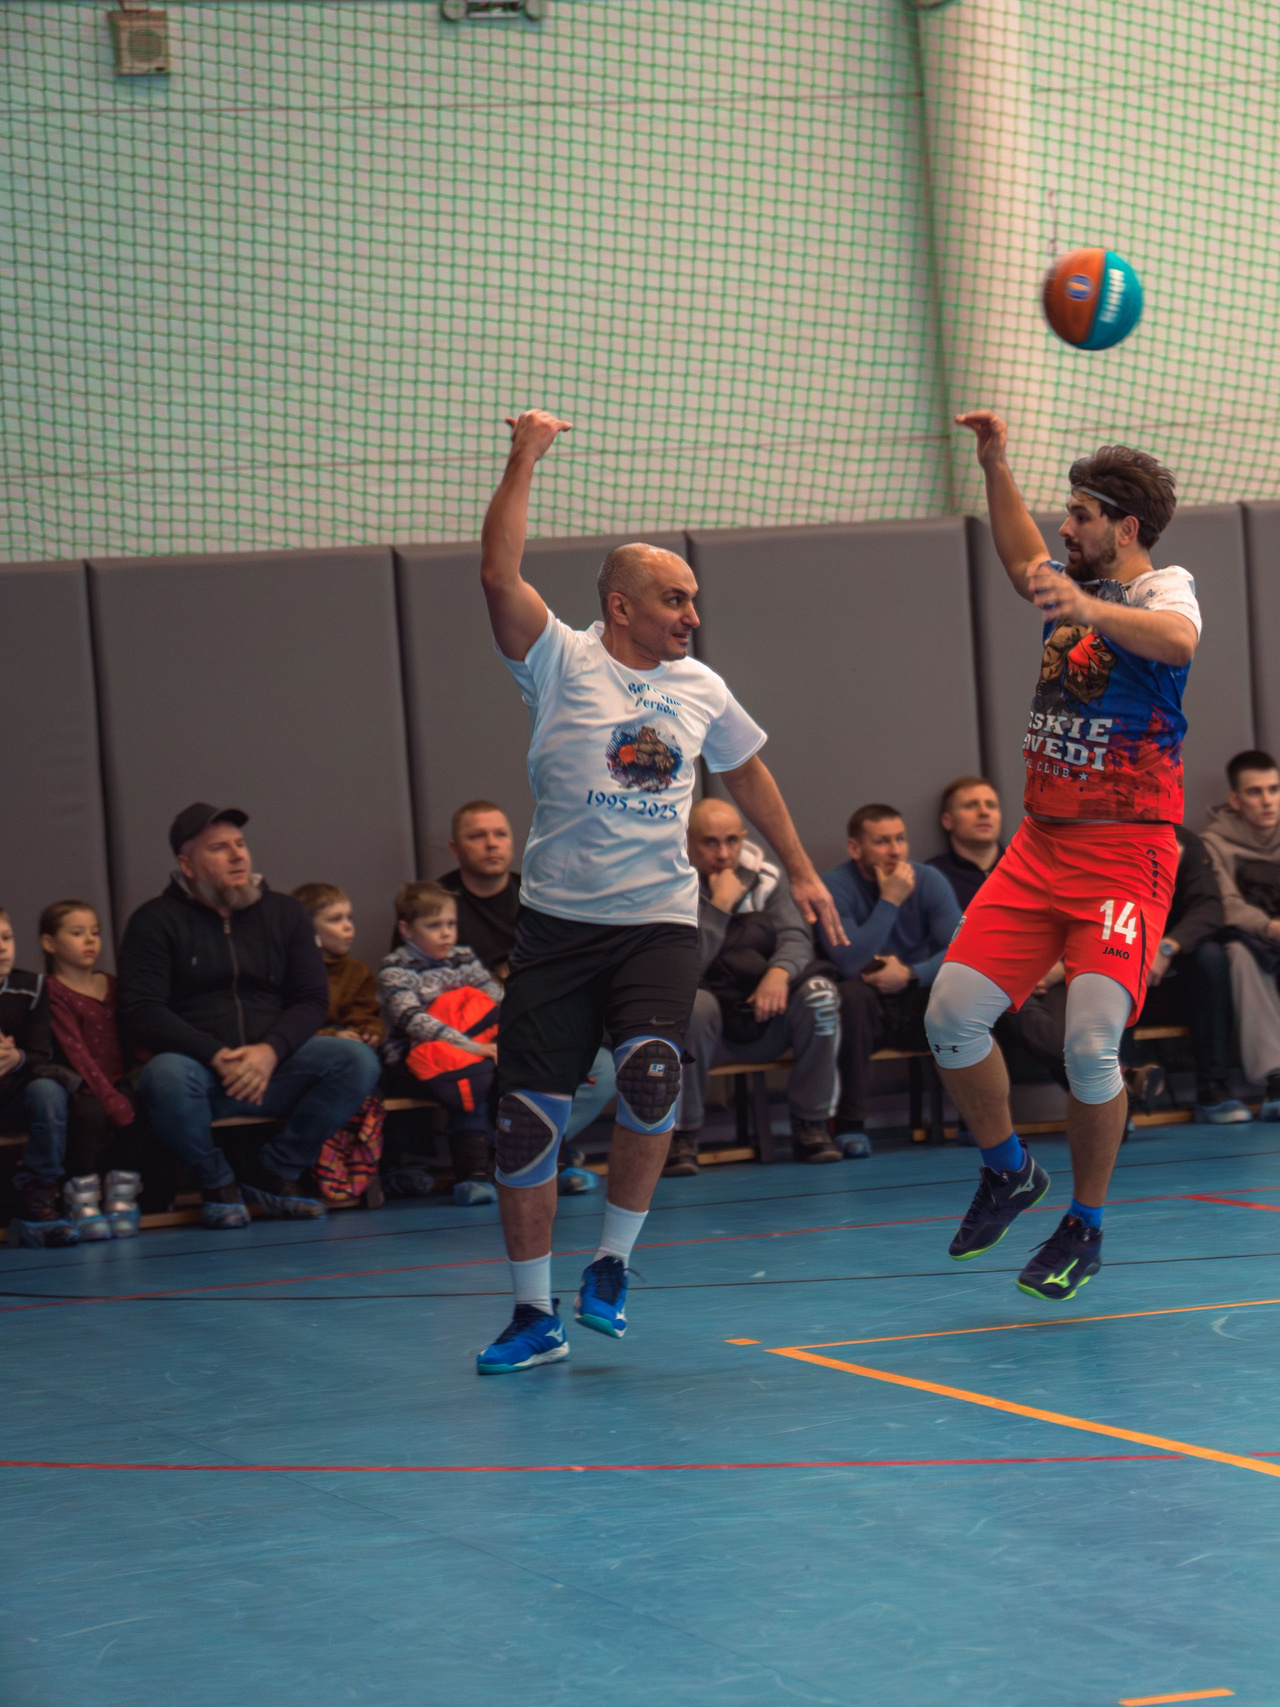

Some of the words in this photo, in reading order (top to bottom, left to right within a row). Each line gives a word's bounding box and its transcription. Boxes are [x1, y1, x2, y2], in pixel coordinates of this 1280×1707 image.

[1036, 761, 1070, 778] CLUB
[586, 789, 678, 820] 1995-2025
[1099, 899, 1137, 945] 14
[1101, 946, 1130, 960] JAKO
